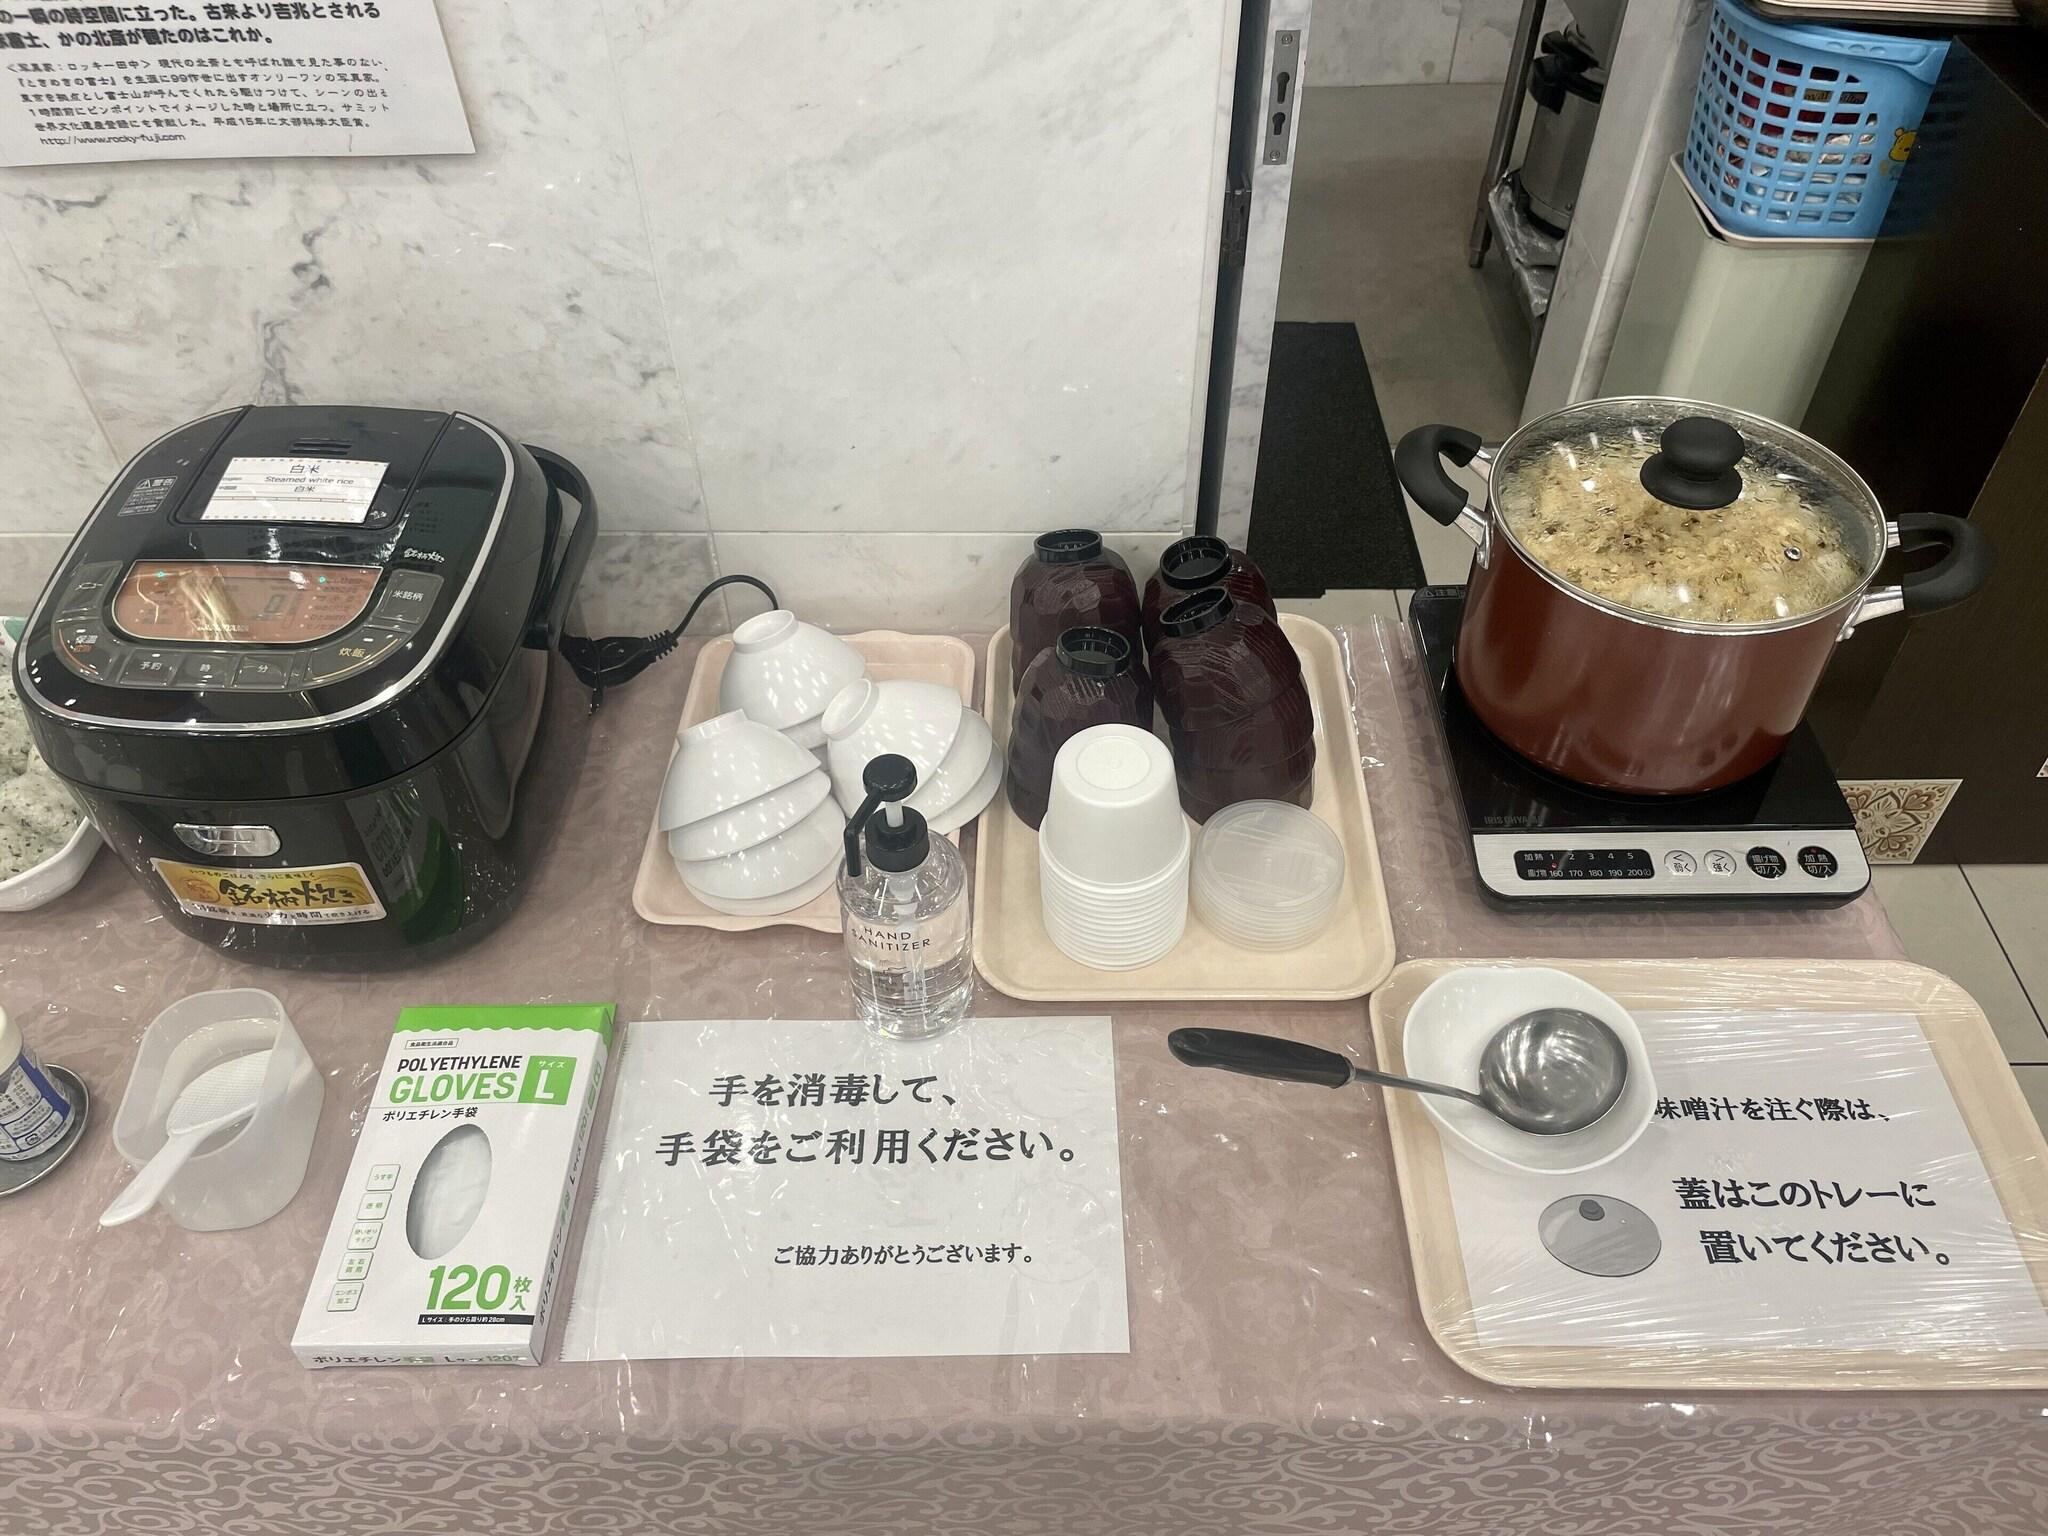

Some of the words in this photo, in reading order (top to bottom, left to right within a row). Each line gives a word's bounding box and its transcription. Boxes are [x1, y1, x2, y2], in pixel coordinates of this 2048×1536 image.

[290, 464, 320, 474] 白米
[265, 476, 306, 484] Steamed
[308, 477, 335, 485] white
[294, 485, 316, 493] 白米
[338, 647, 366, 659] 炊飯
[257, 663, 268, 673] 分
[1569, 853, 1575, 861] 2
[1588, 852, 1595, 860] 3
[1607, 852, 1615, 860] 4
[1627, 852, 1634, 860] 5
[1751, 854, 1779, 864] 揚げ物
[1804, 854, 1829, 863] 加熱
[1550, 869, 1564, 878] 160
[1569, 869, 1583, 877] 170
[1588, 869, 1603, 877] 180
[1608, 869, 1623, 877] 190
[1712, 862, 1731, 873] 強く
[851, 928, 931, 951] SANITIZER
[863, 926, 911, 941] HAND
[397, 1055, 522, 1073] POLYETHYLENE
[538, 1060, 566, 1069] サイズ
[389, 1072, 518, 1104] GLOVES
[534, 1069, 555, 1100] L
[708, 1073, 957, 1108] 手を消毒して、
[382, 1107, 478, 1122] ポリエチレン手袋
[1654, 1096, 1890, 1122] 味噌汁を注ぐ際は、
[655, 1127, 1077, 1167] 手袋をご利用ください。
[1672, 1177, 1937, 1210] 蓋はこのトレーに
[774, 1243, 1034, 1266] ご協力ありがとうございます。
[1699, 1229, 1951, 1266] 置いてください。
[426, 1264, 512, 1311] 120
